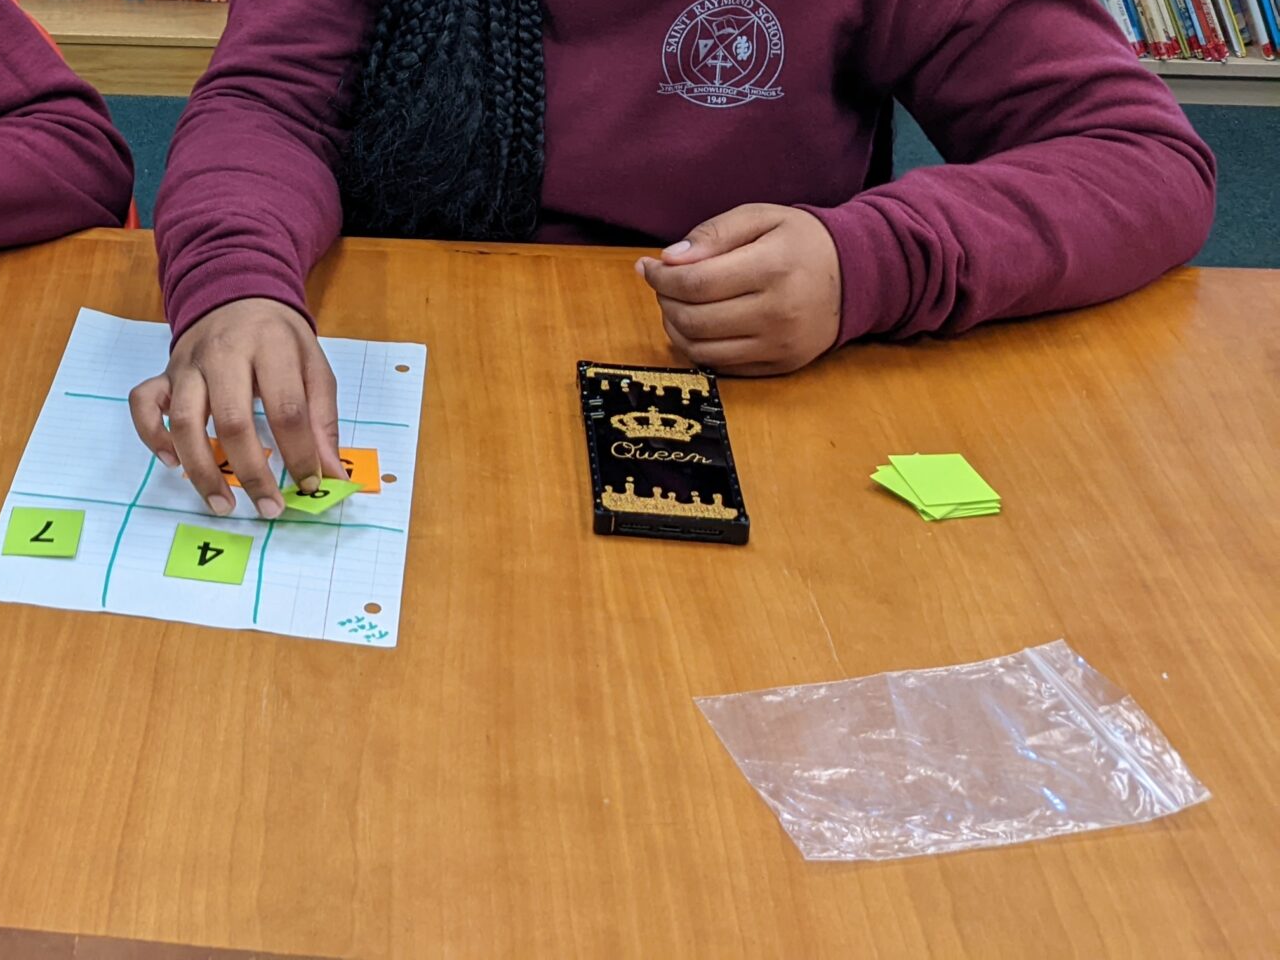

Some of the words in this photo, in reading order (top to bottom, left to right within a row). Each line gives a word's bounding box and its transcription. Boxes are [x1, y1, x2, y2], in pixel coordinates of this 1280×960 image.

[666, 14, 691, 53] SAINT
[756, 7, 781, 58] SCHOOL
[694, 87, 738, 95] KNOWLEDGE
[706, 96, 727, 104] 1949
[610, 441, 713, 464] Queen
[30, 520, 55, 544] 7
[196, 540, 225, 567] 4
